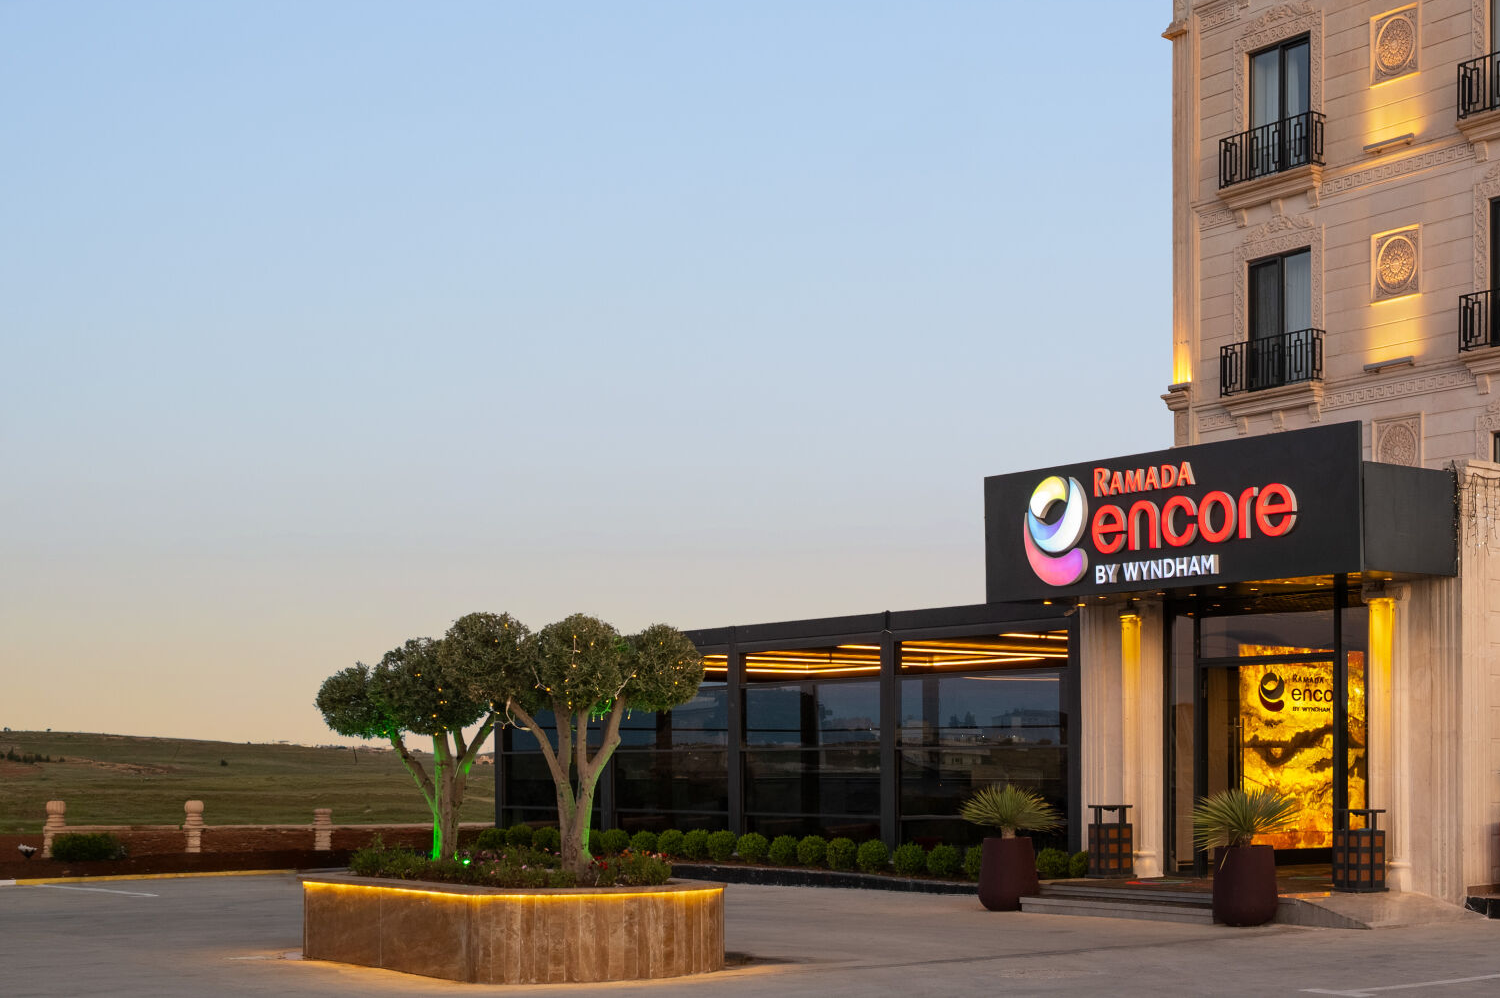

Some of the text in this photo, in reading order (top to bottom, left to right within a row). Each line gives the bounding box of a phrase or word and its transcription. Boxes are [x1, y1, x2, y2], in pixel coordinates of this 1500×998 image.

[1094, 461, 1196, 498] RAMADA
[1092, 482, 1298, 555] encore
[1095, 554, 1220, 585] BY WYNDHAM
[1291, 688, 1334, 702] enco
